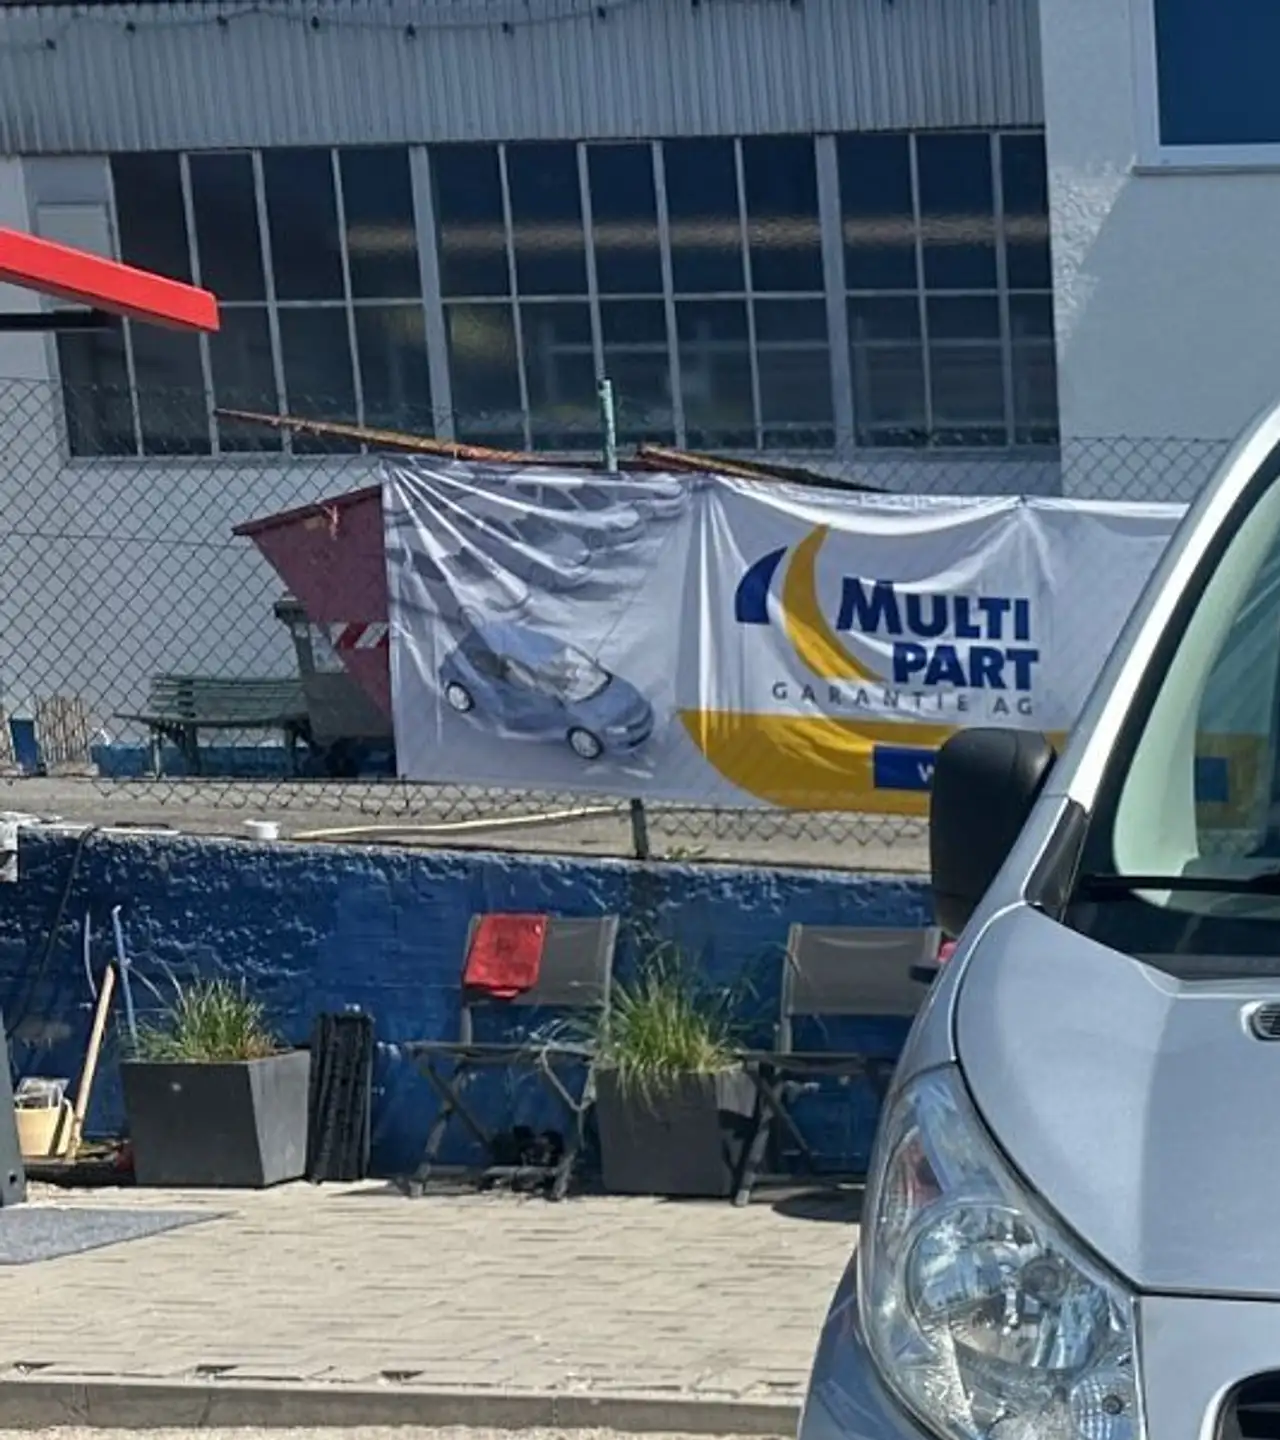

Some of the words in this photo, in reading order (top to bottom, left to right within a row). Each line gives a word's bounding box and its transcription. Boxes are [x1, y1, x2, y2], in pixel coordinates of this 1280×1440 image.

[836, 575, 1030, 641] MULTI
[892, 641, 1040, 691] PART
[771, 681, 970, 712] GARANTIE
[992, 696, 1033, 716] AG
